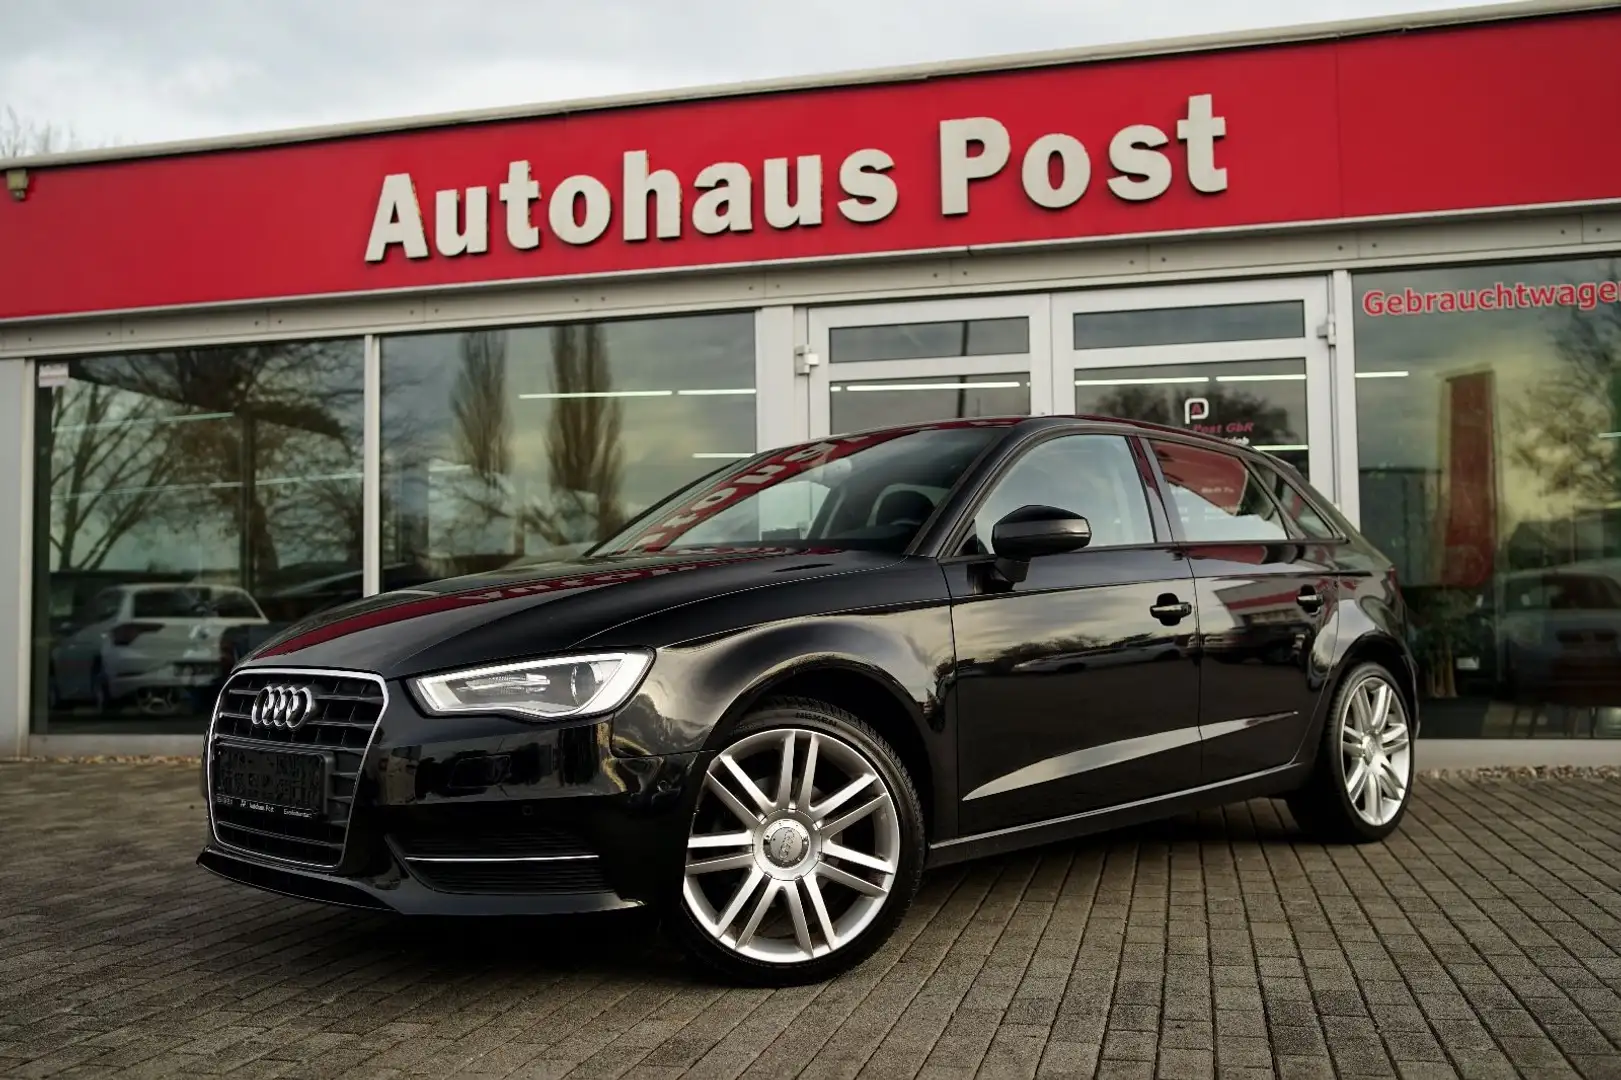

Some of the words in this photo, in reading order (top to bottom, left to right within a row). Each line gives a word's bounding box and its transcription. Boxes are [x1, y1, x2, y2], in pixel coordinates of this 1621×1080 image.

[364, 148, 898, 262] Autohaus
[940, 93, 1228, 215] Post
[1363, 281, 1621, 317] Gebrauchtwage
